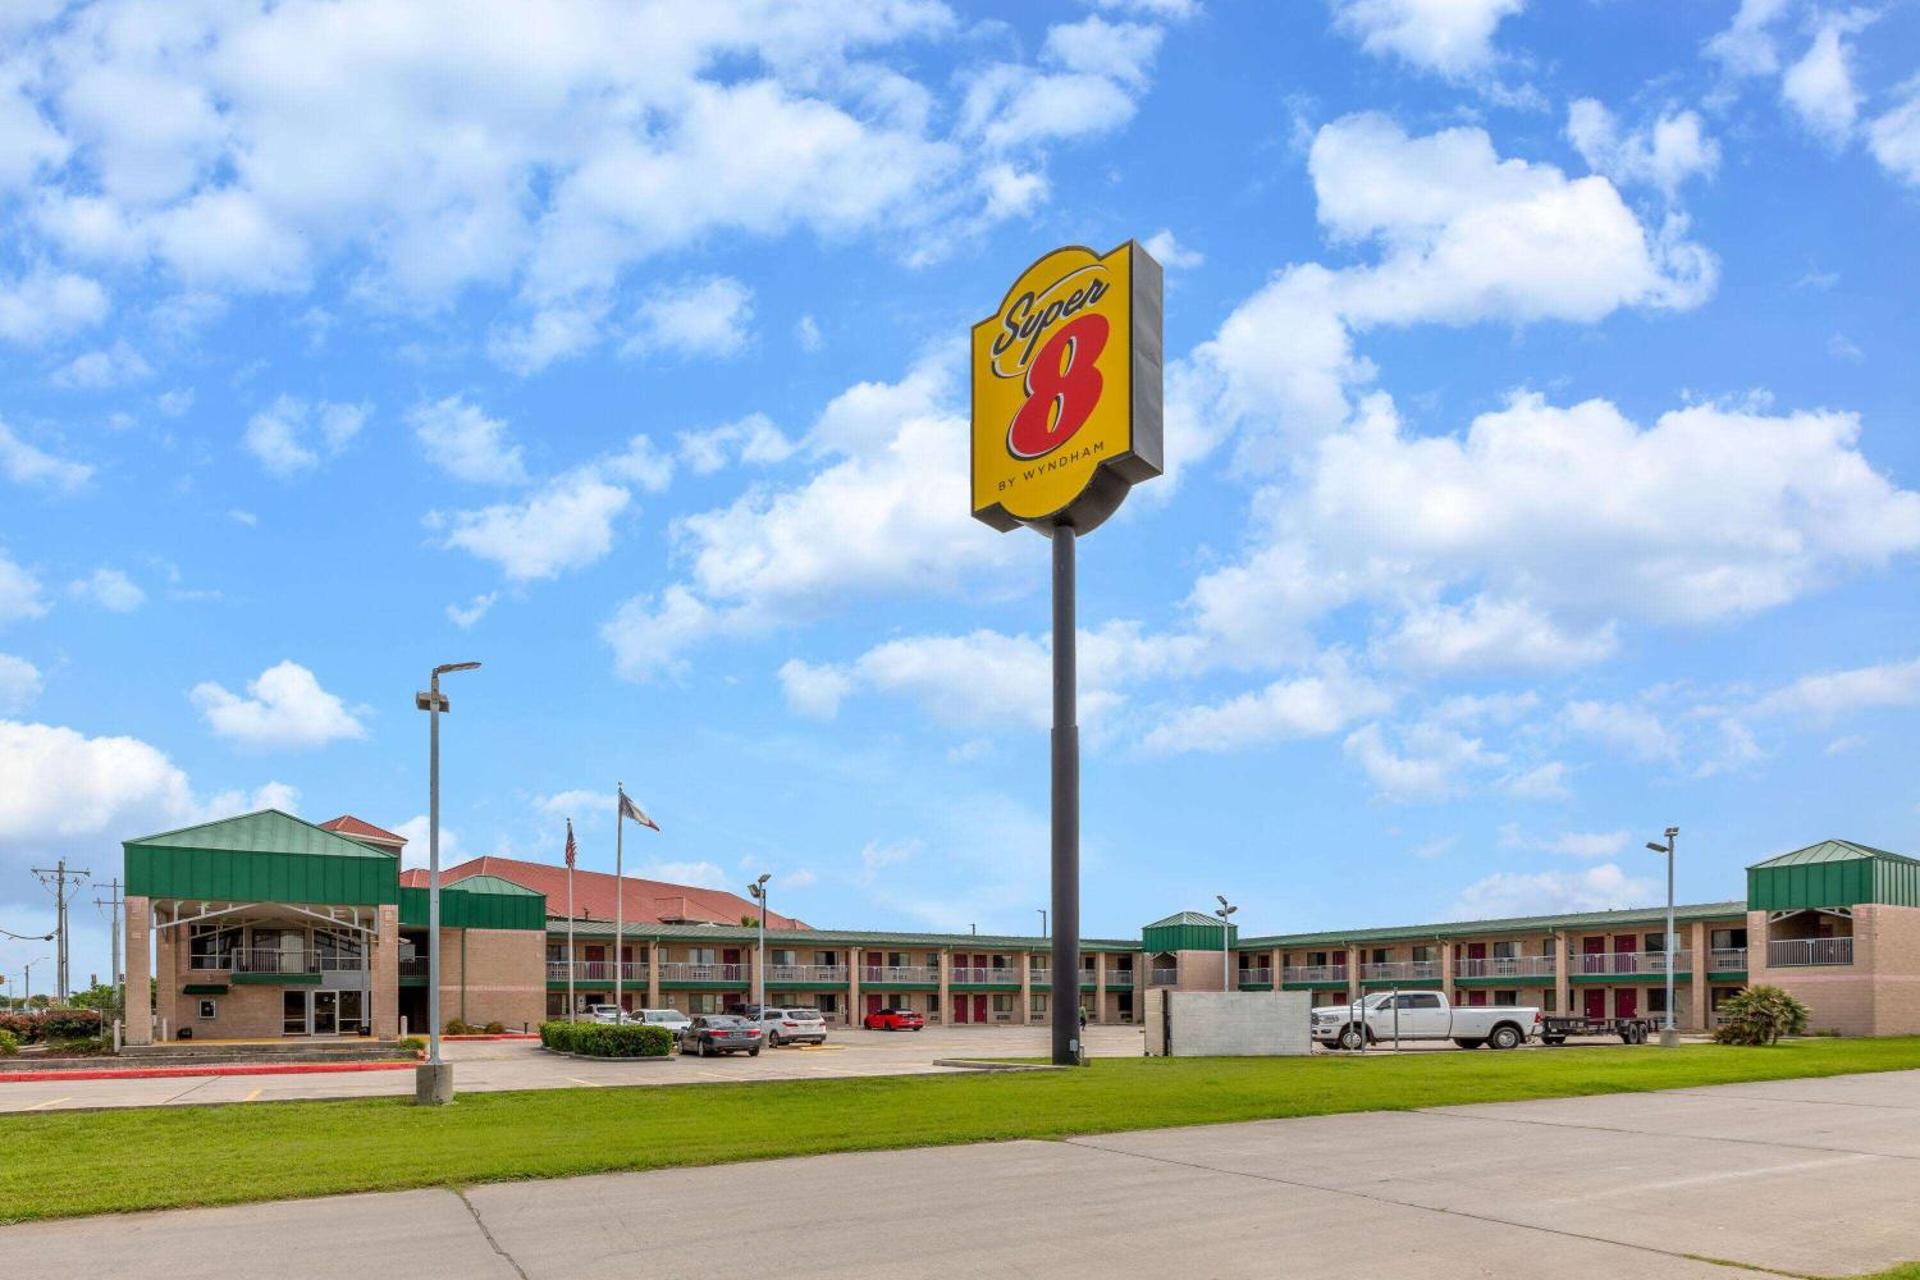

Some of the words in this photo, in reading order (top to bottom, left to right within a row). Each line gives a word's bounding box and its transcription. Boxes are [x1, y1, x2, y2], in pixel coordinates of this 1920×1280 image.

[990, 278, 1111, 367] Super
[1006, 313, 1110, 461] 8
[998, 477, 1016, 491] BY
[1023, 440, 1105, 481] WYNDHAM
